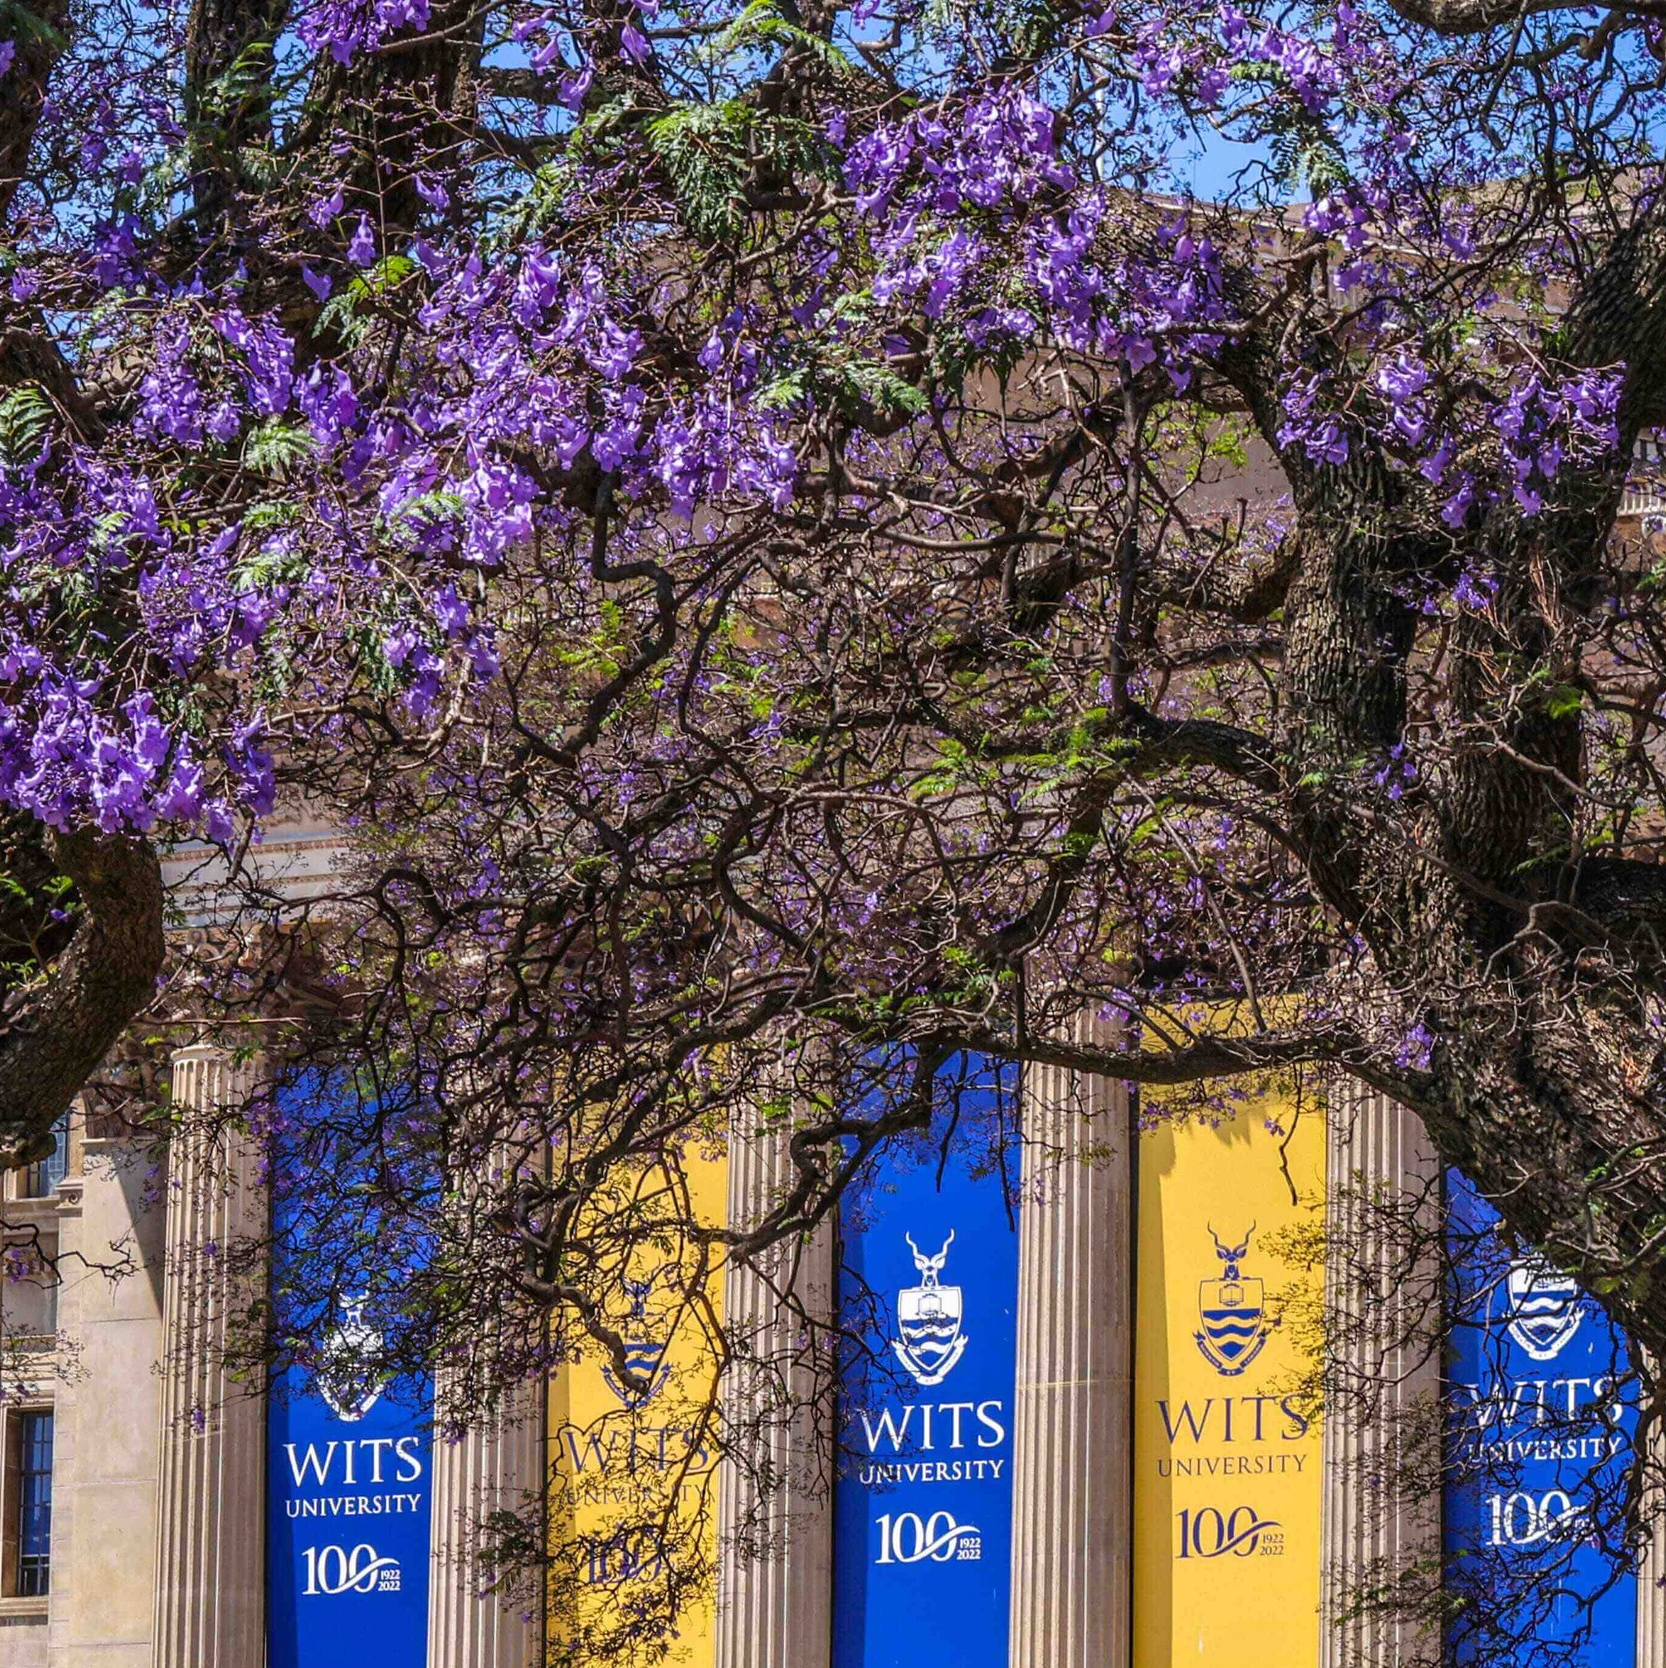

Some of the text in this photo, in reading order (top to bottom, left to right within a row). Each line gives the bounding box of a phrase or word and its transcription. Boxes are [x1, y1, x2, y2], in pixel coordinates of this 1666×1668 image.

[856, 1400, 1005, 1452] WITS
[1155, 1394, 1308, 1445] WITS
[283, 1436, 422, 1487] WITS
[859, 1459, 1005, 1485] UNIVERSITY
[1157, 1453, 1308, 1478] UNIVERSITY
[285, 1493, 422, 1518] UNIVERSITY
[1485, 1490, 1572, 1546] 100
[875, 1511, 958, 1564] 100
[959, 1537, 981, 1548] 1922
[1175, 1505, 1259, 1559] 100
[1262, 1533, 1284, 1544] 1922
[956, 1548, 981, 1560] 2022
[1259, 1544, 1284, 1556] 2022
[301, 1543, 379, 1595] 100
[380, 1569, 401, 1580] 1922
[377, 1580, 401, 1592] 2022
